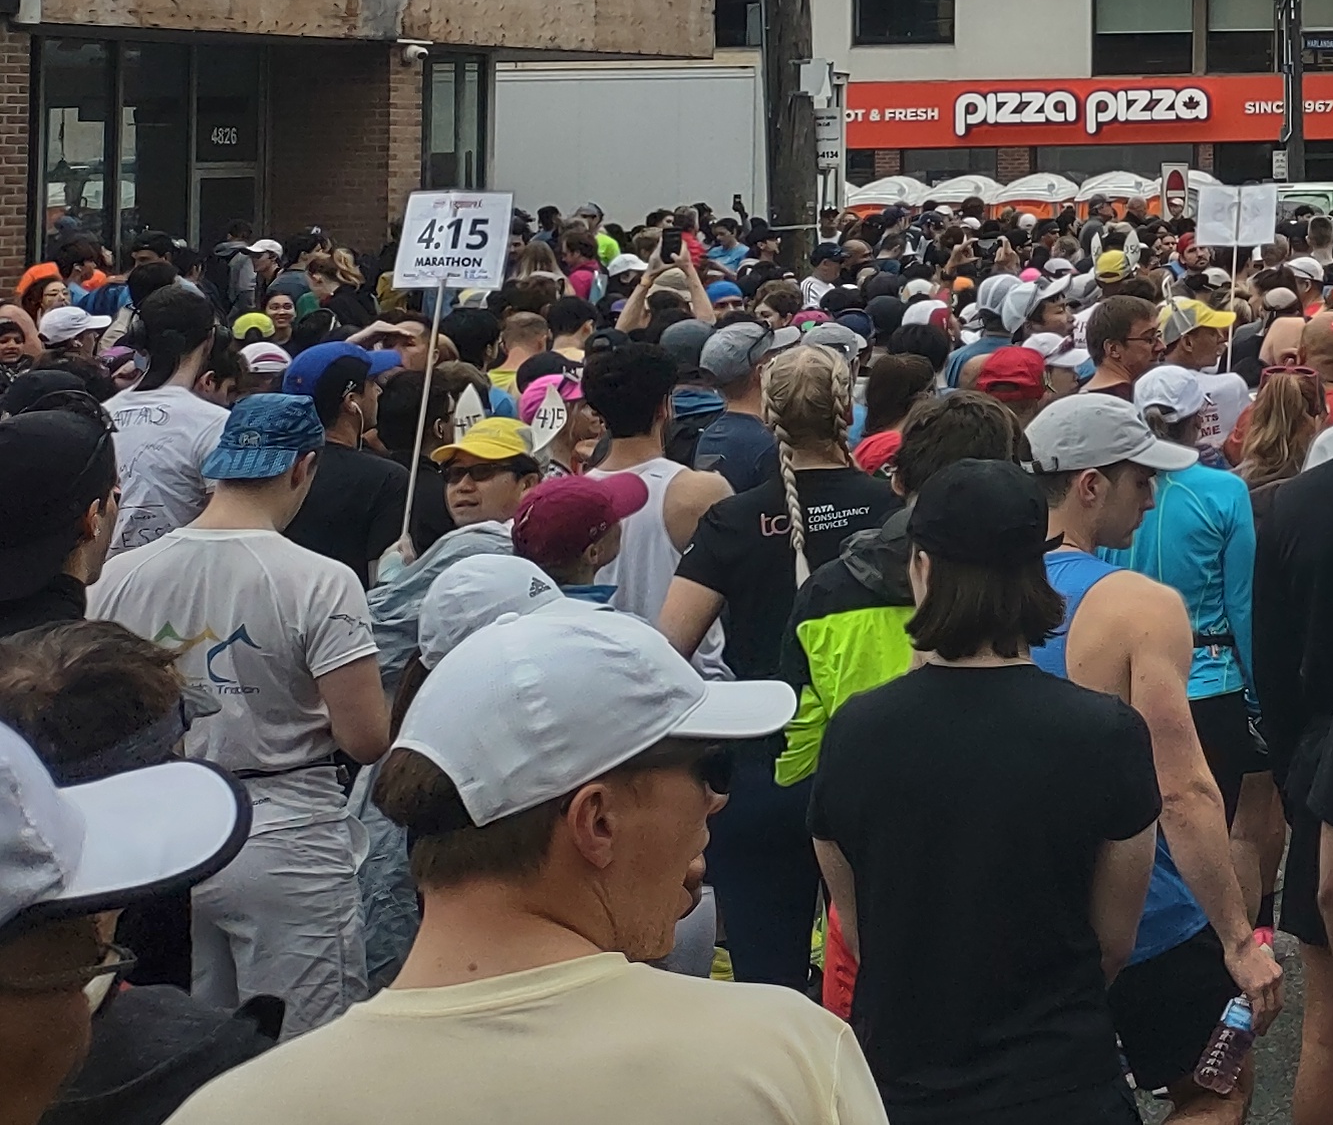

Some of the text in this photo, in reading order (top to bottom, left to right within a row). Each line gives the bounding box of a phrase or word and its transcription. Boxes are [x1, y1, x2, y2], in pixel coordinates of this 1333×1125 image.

[845, 107, 939, 122] OT & FRESH
[955, 87, 1209, 136] pizza pizza
[1244, 100, 1284, 115] SINC
[211, 126, 237, 144] 4826
[416, 217, 490, 250] 4:15
[414, 256, 483, 267] MARATHON
[807, 504, 835, 514] TATA
[808, 507, 870, 524] CONSULTANCY
[808, 519, 849, 532] SERVICES
